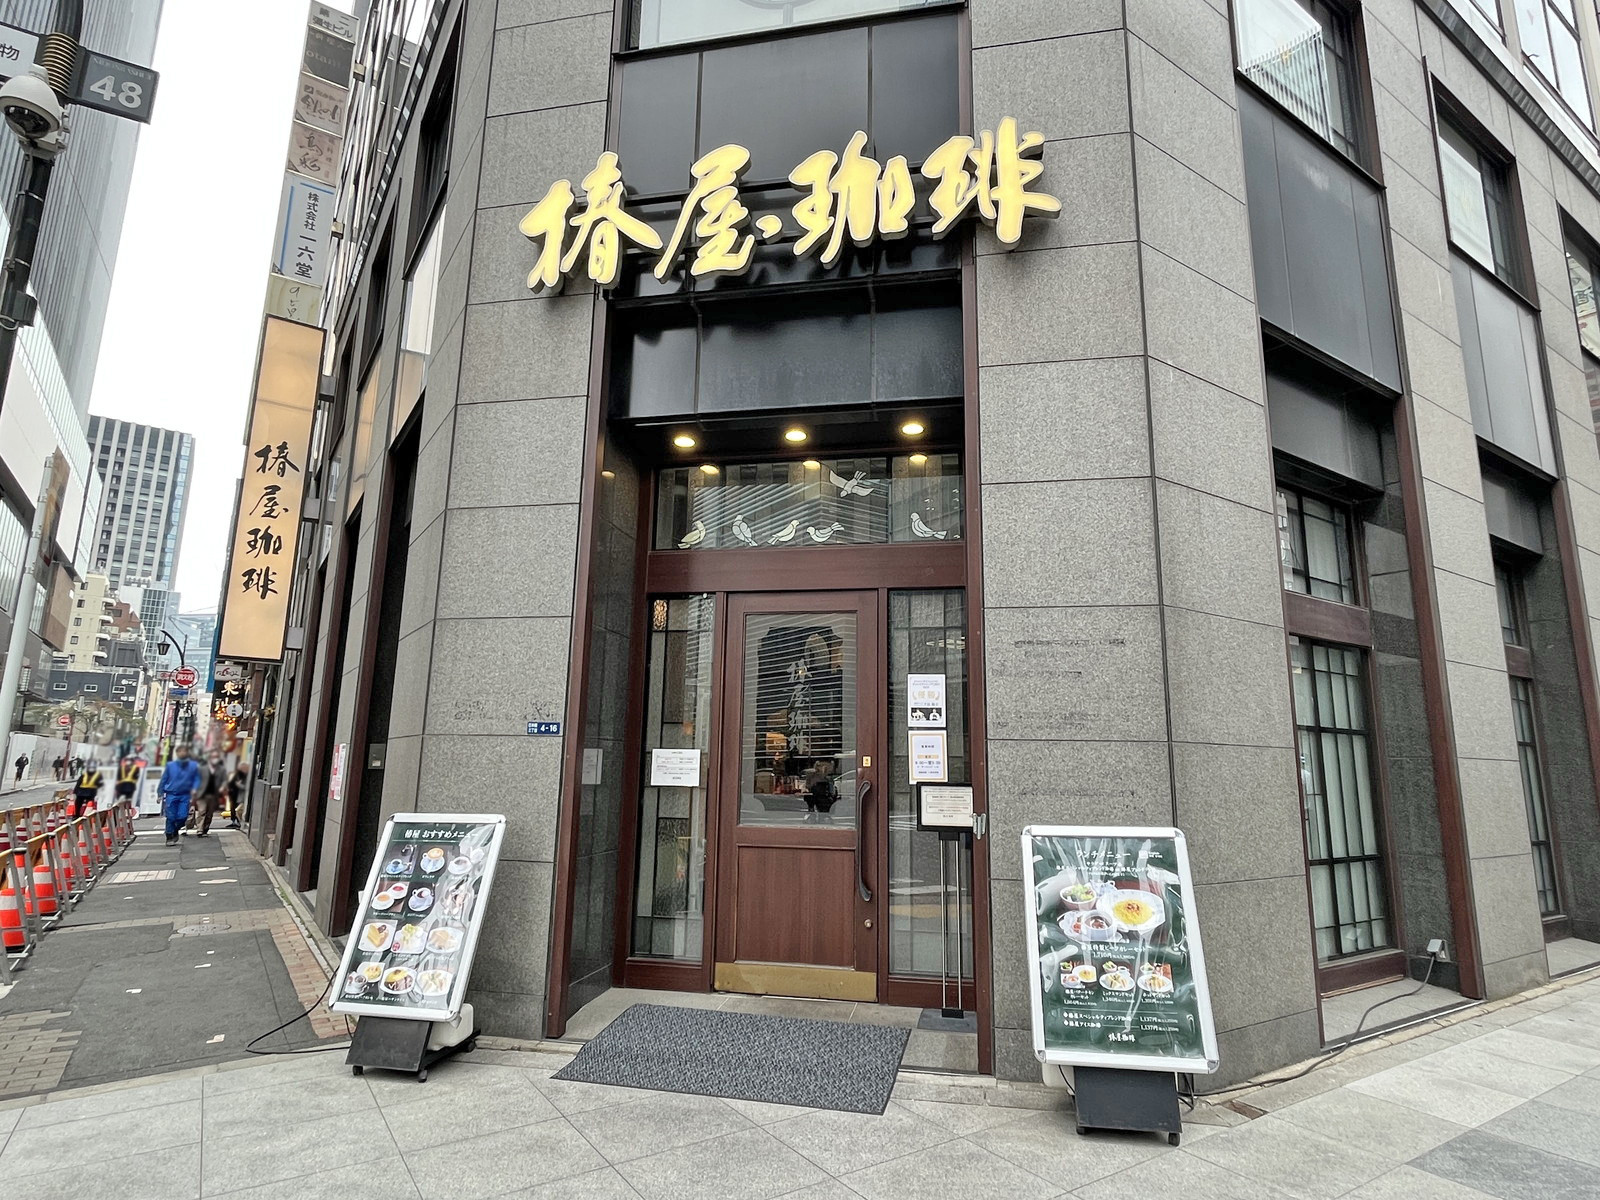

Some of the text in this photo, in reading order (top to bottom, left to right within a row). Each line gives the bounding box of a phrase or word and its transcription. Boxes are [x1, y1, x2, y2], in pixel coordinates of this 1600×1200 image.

[89, 75, 143, 108] 48
[519, 116, 1062, 292] 椿屋珈琲
[241, 441, 300, 600] 椿屋珈琲
[540, 724, 558, 733] 4-16
